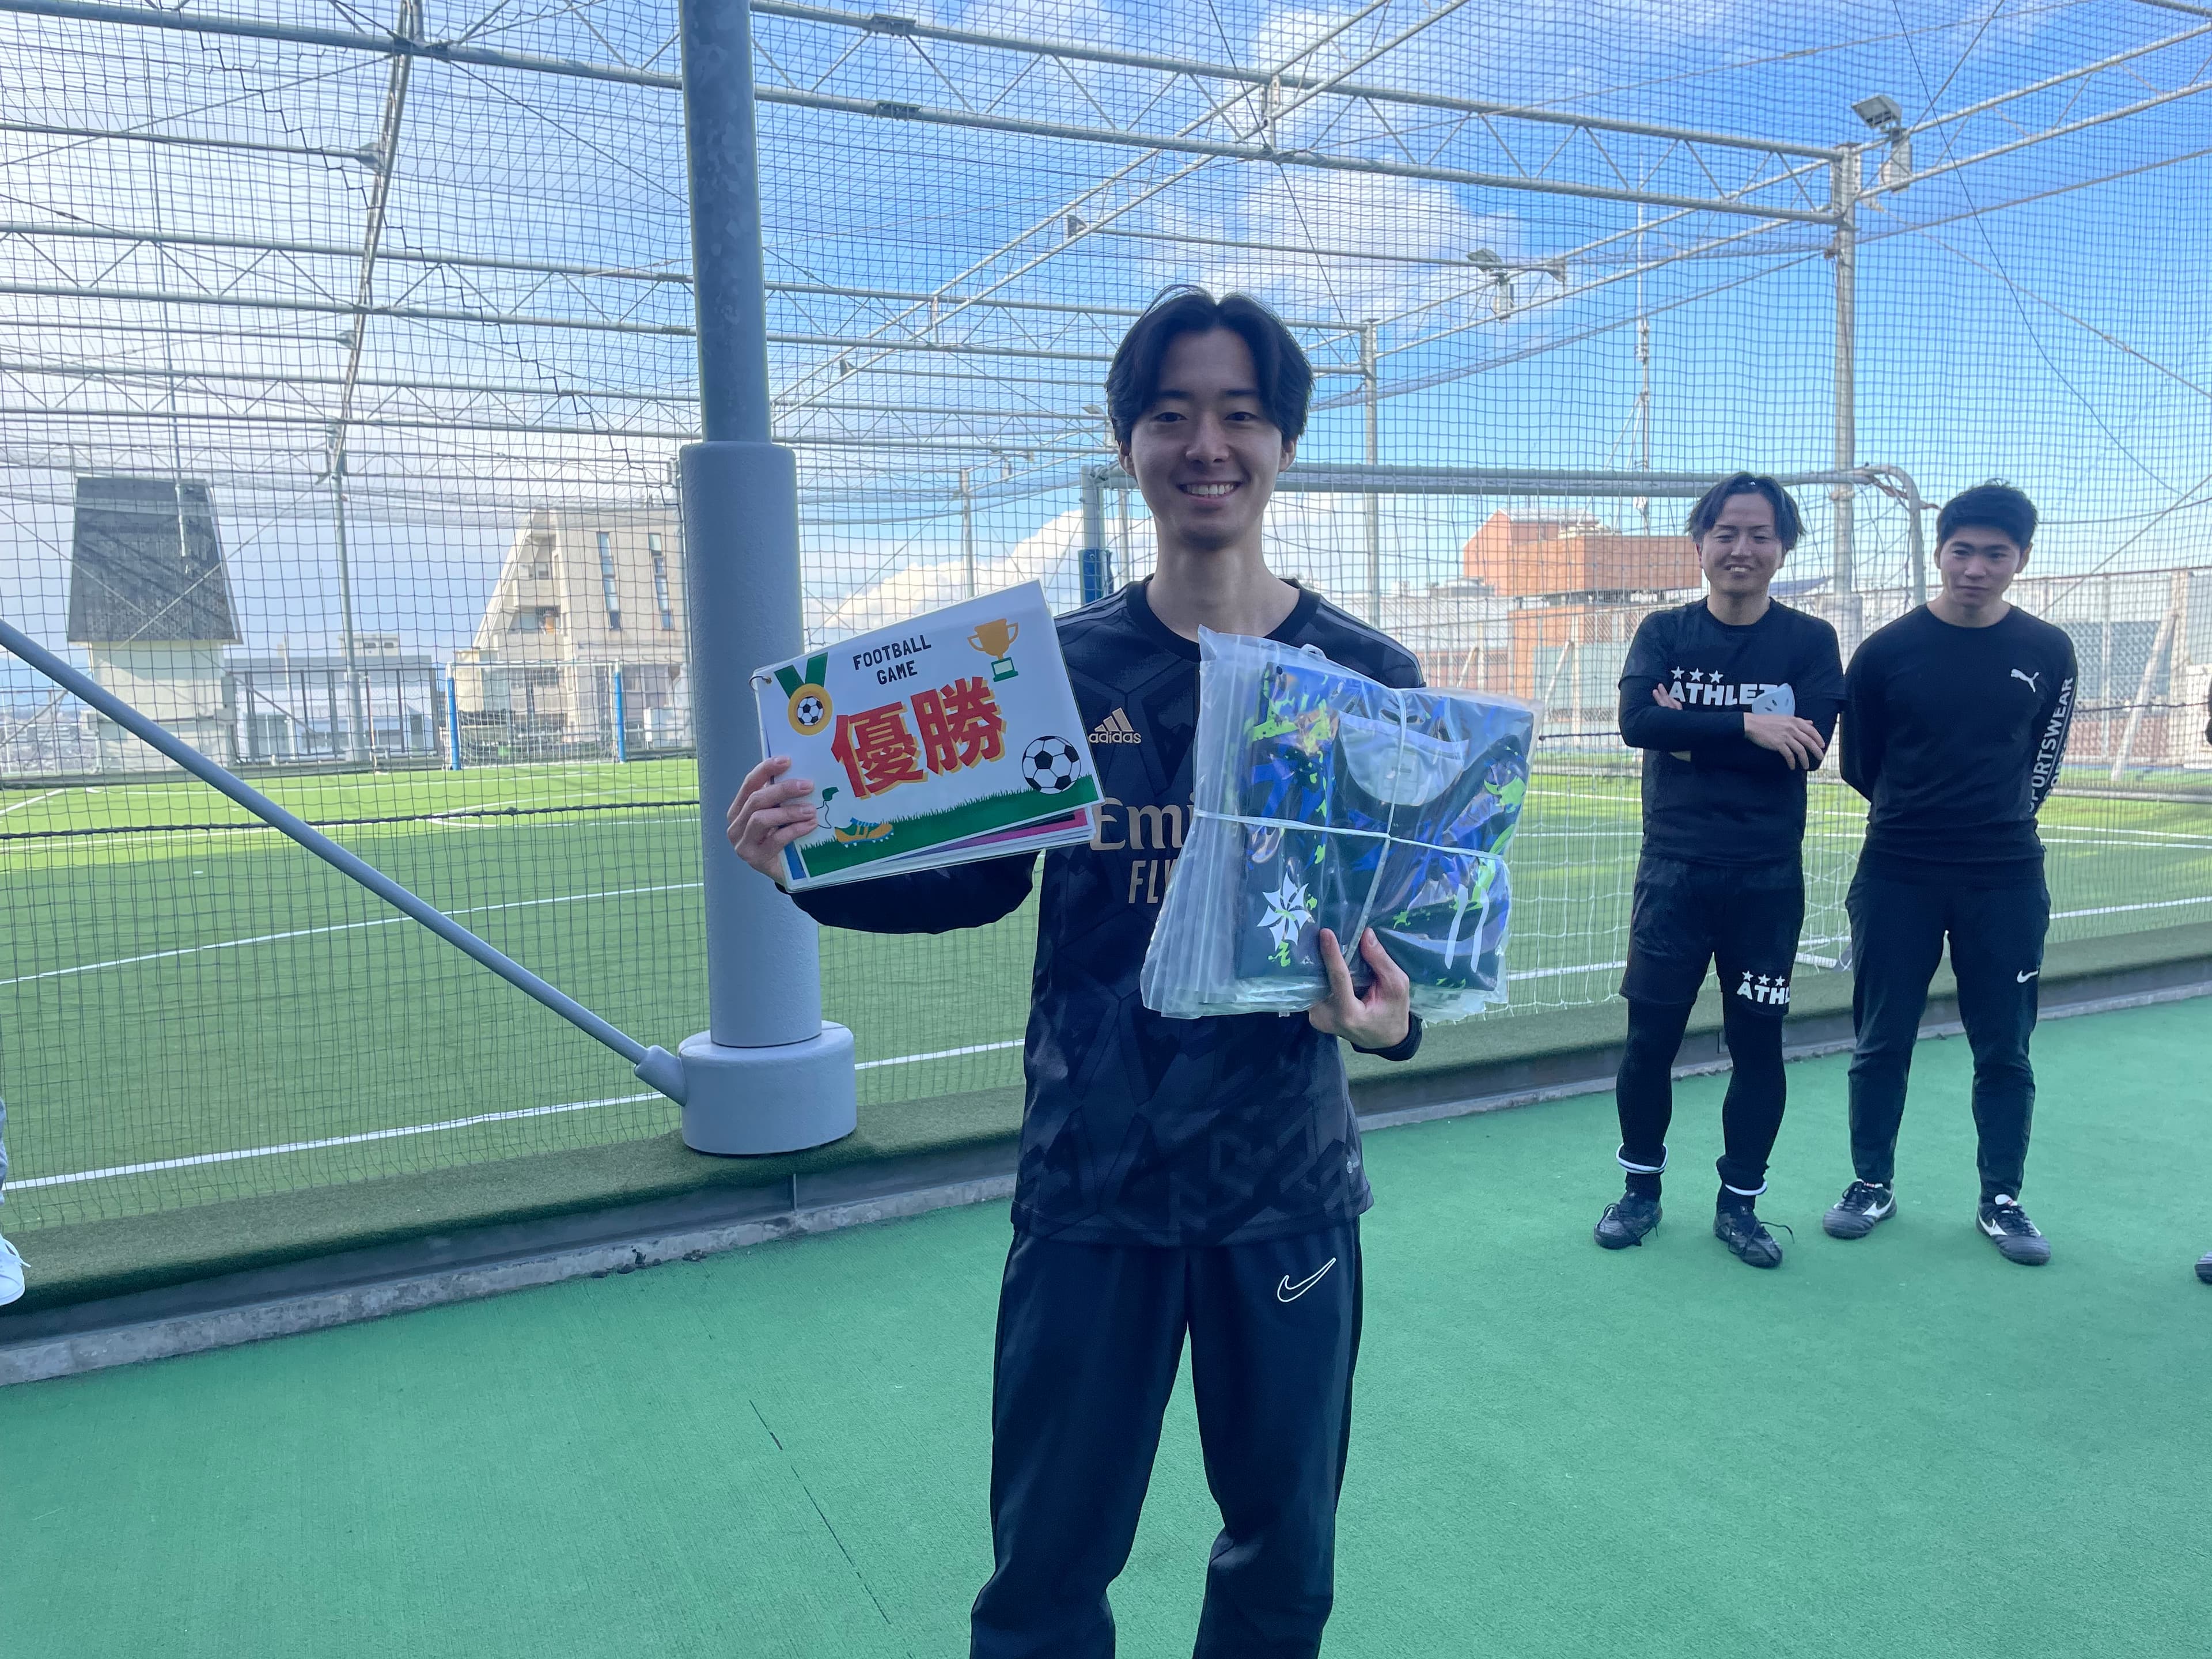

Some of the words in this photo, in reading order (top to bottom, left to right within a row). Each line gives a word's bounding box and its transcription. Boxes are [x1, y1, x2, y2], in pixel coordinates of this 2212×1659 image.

[853, 635, 931, 671] FOOTBALL
[877, 660, 918, 685] GAME
[831, 676, 1007, 800] 優勝
[1089, 731, 1141, 744] adidas
